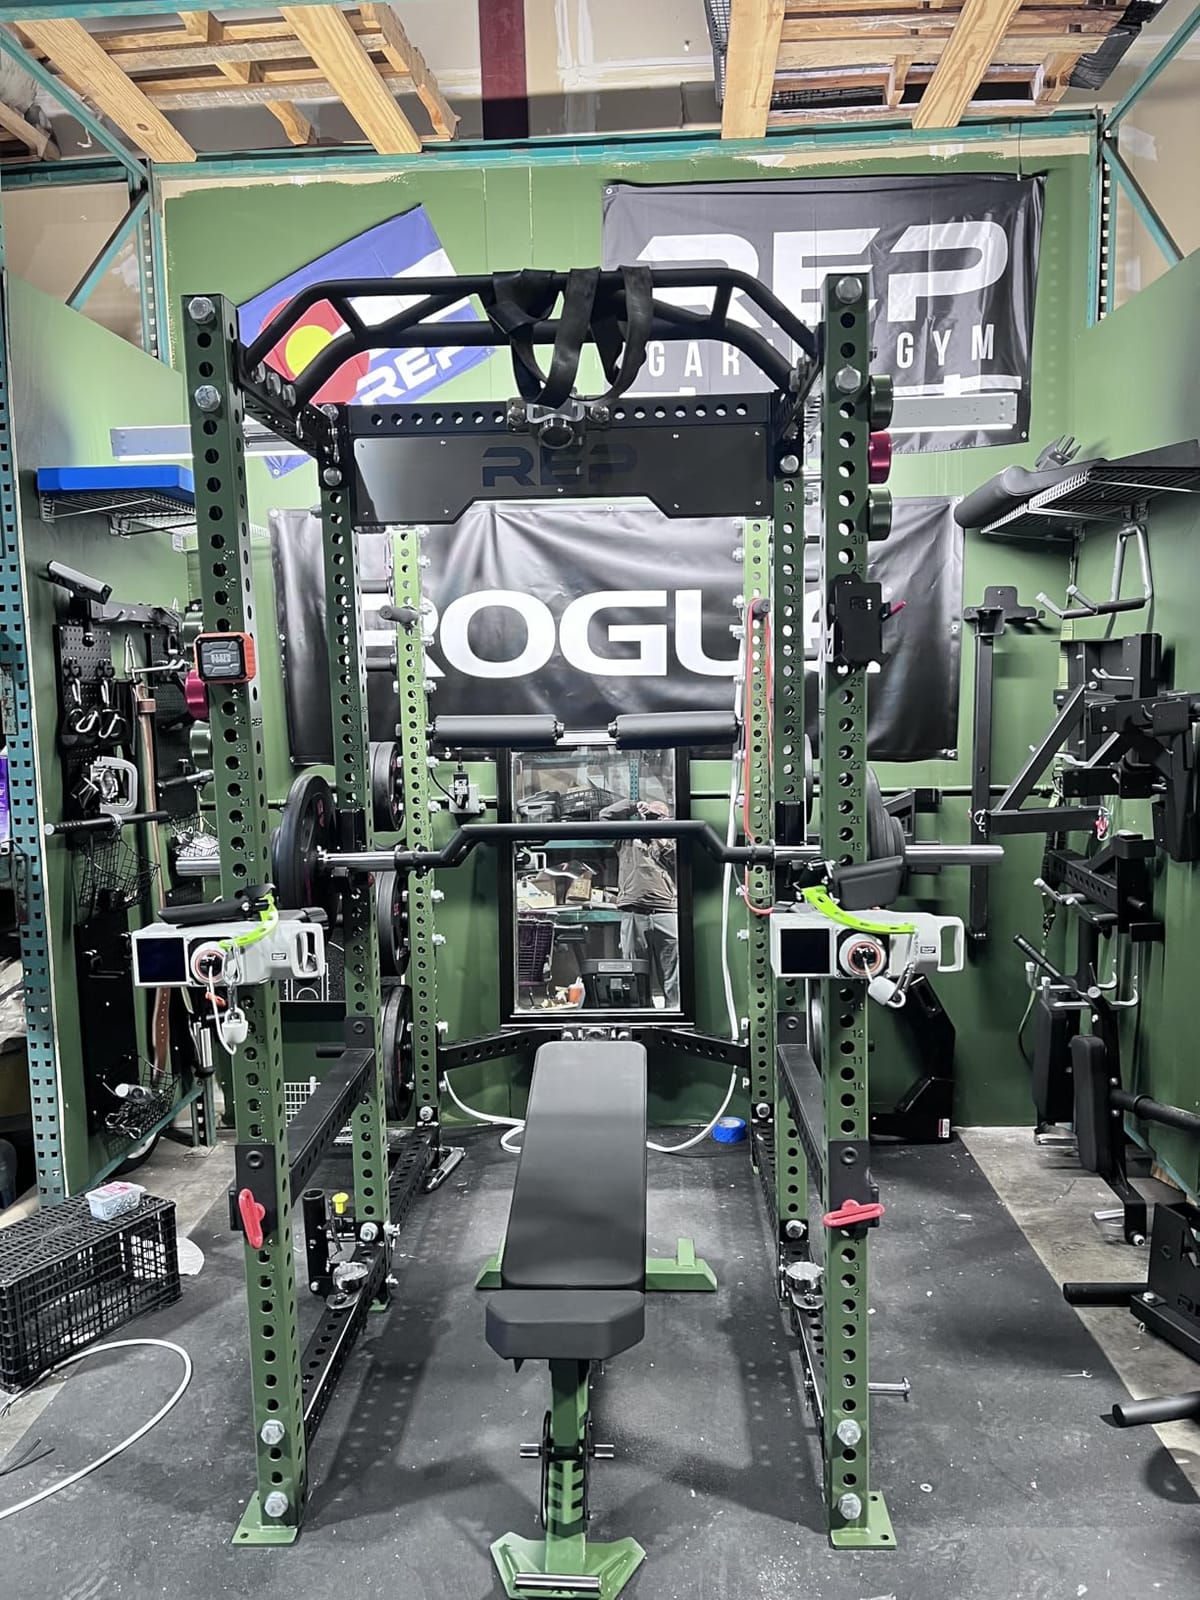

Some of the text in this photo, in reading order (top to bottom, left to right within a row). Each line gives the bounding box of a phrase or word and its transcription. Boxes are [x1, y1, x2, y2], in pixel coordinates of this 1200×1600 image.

[636, 220, 1009, 328] REP
[896, 323, 994, 368] GYM
[482, 443, 638, 487] REP
[362, 590, 878, 679] ROGU
[850, 760, 862, 770] 22
[850, 788, 862, 798] 21
[852, 1030, 864, 1038] 12
[852, 1056, 862, 1064] 11
[854, 1288, 860, 1297] 2
